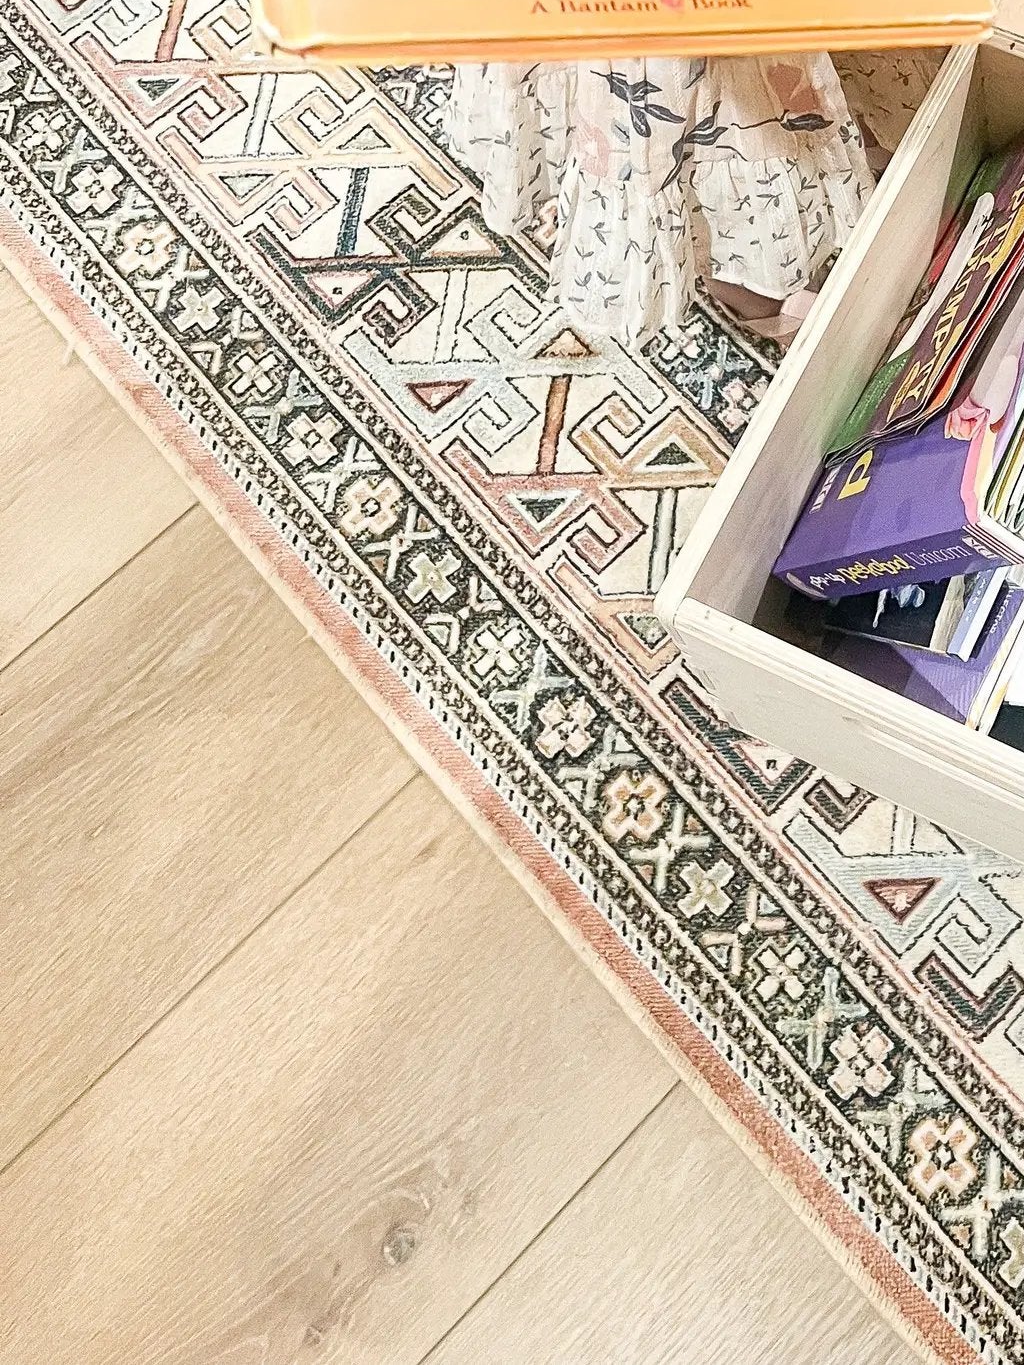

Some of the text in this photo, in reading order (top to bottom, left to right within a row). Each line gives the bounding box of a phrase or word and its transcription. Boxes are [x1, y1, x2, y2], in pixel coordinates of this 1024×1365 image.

[531, 0, 549, 15] A
[902, 232, 992, 404] DUMPTY
[905, 545, 973, 566] Unicorn
